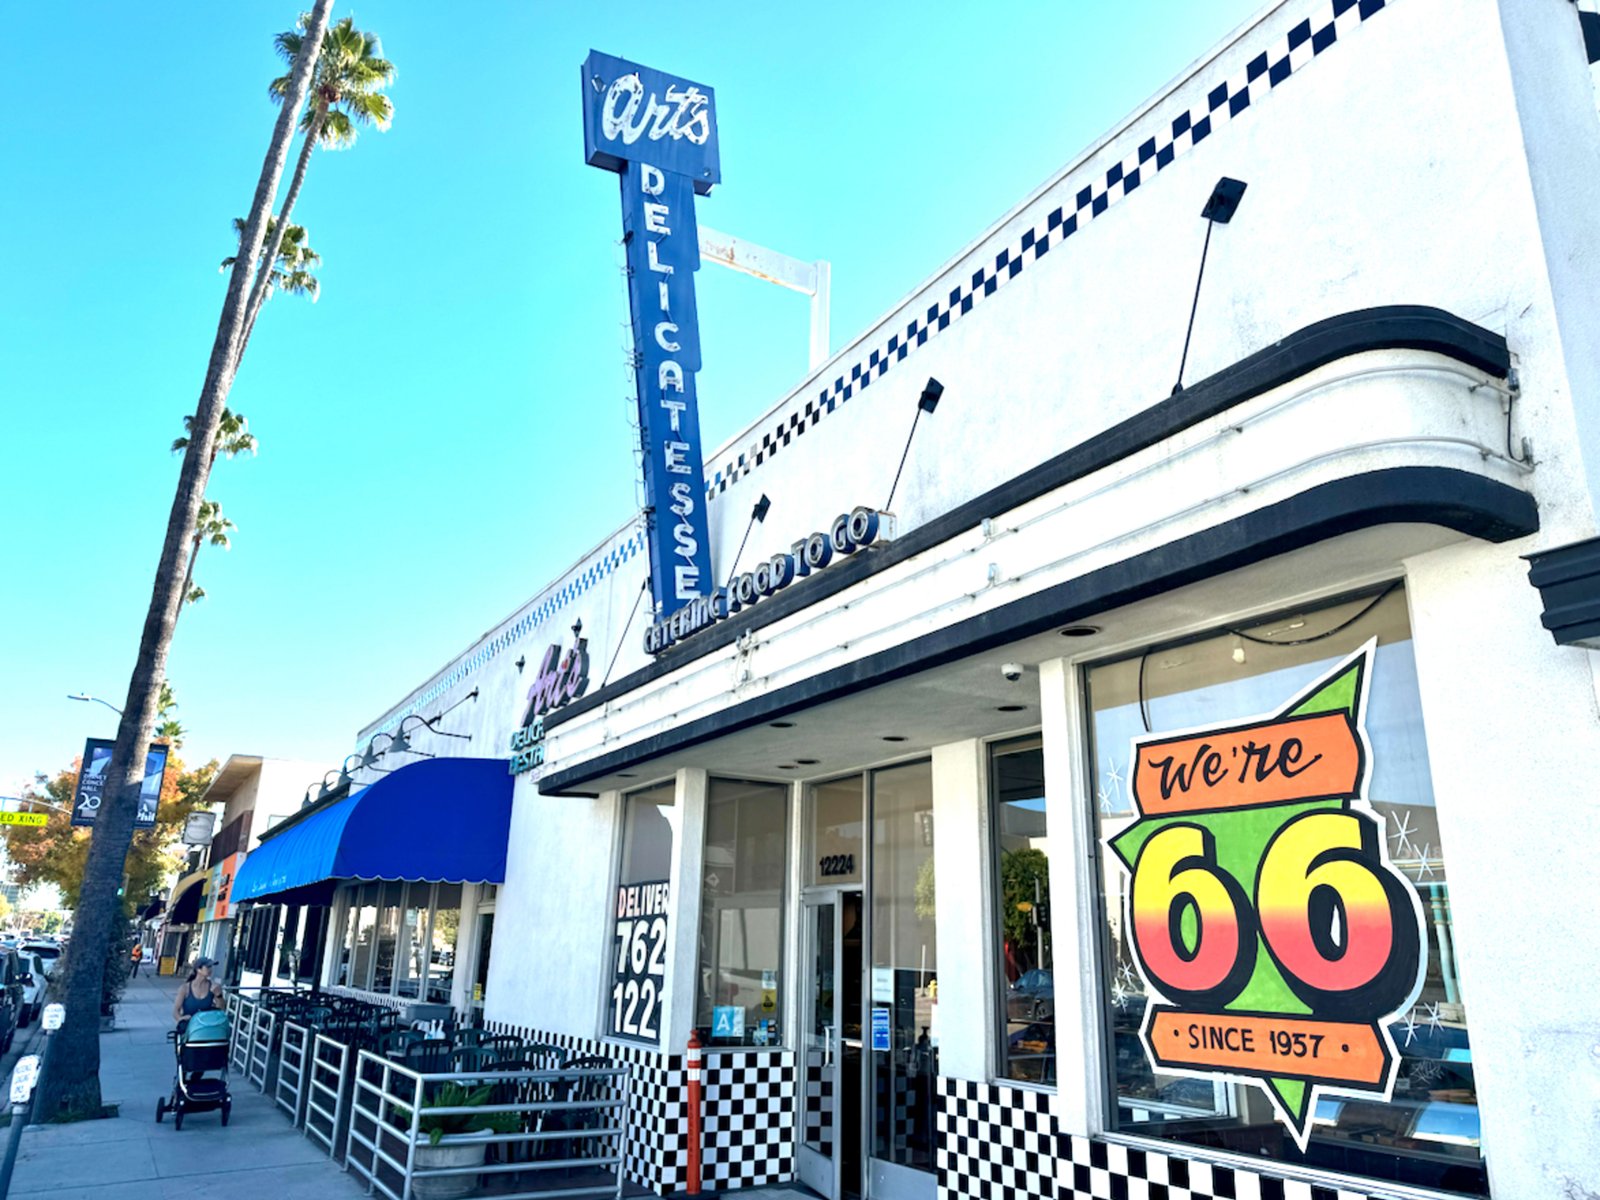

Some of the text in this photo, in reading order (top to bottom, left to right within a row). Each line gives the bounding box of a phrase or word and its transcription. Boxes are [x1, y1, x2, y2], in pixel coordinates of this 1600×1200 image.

[643, 505, 879, 654] CATERING FOOD TO GO
[1148, 738, 1323, 801] We're
[78, 792, 101, 810] 20
[0, 814, 43, 825] ED XING
[819, 853, 854, 877] 12224
[1131, 808, 1404, 1003] 66
[716, 1013, 731, 1031] A
[1188, 1024, 1325, 1058] SINCE 1957
